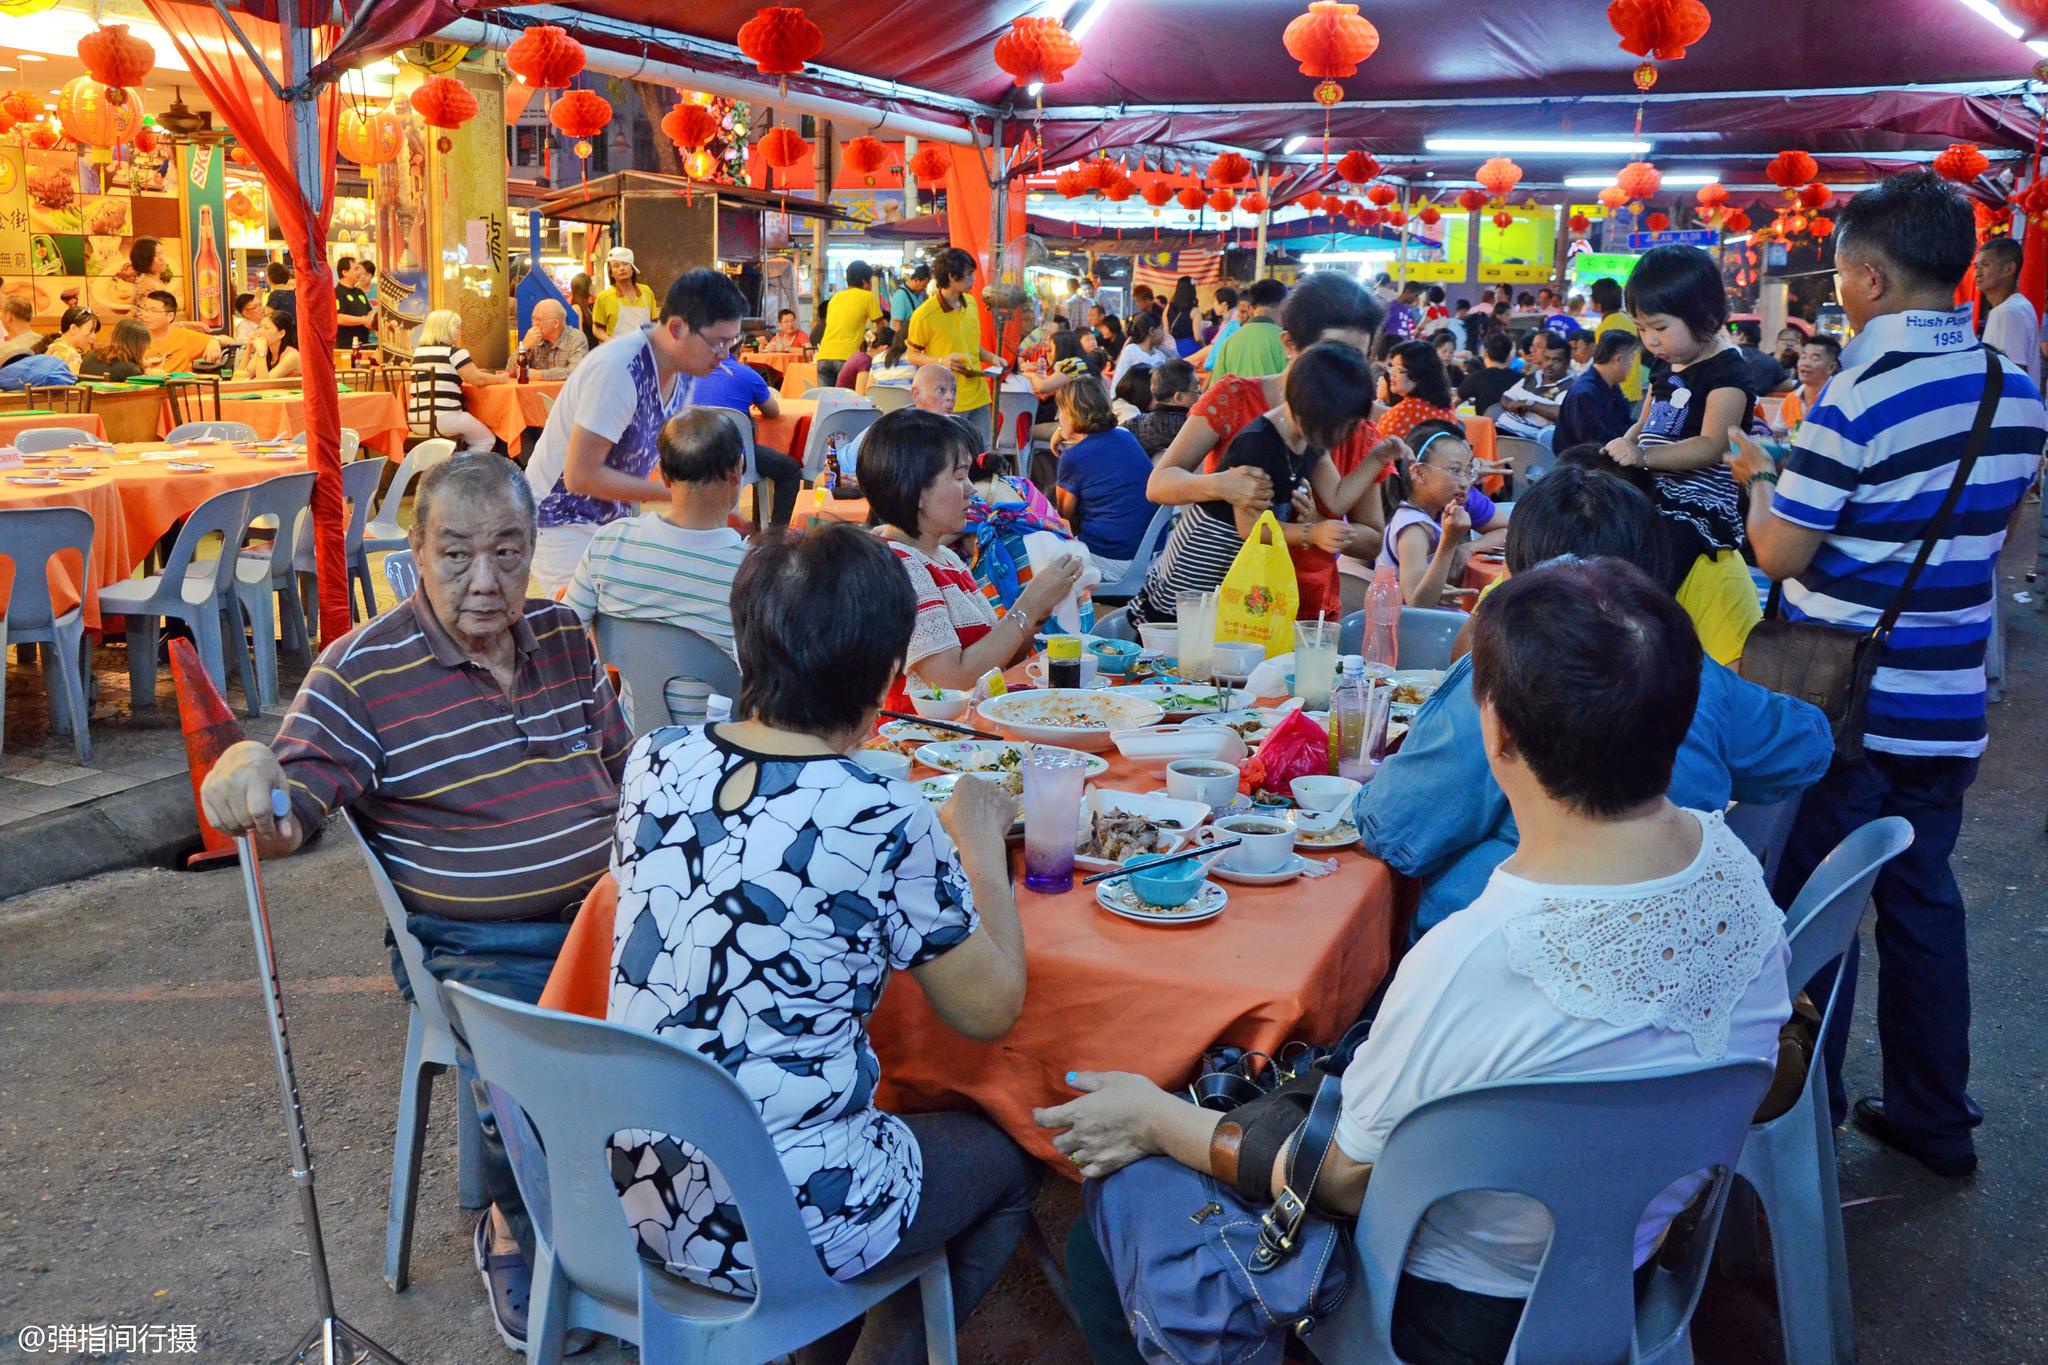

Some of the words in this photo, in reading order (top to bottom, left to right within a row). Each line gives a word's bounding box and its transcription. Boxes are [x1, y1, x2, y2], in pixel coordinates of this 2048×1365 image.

[1320, 84, 1336, 100] 福
[1906, 315, 1943, 328] Hush
[1933, 330, 1964, 347] 1958
